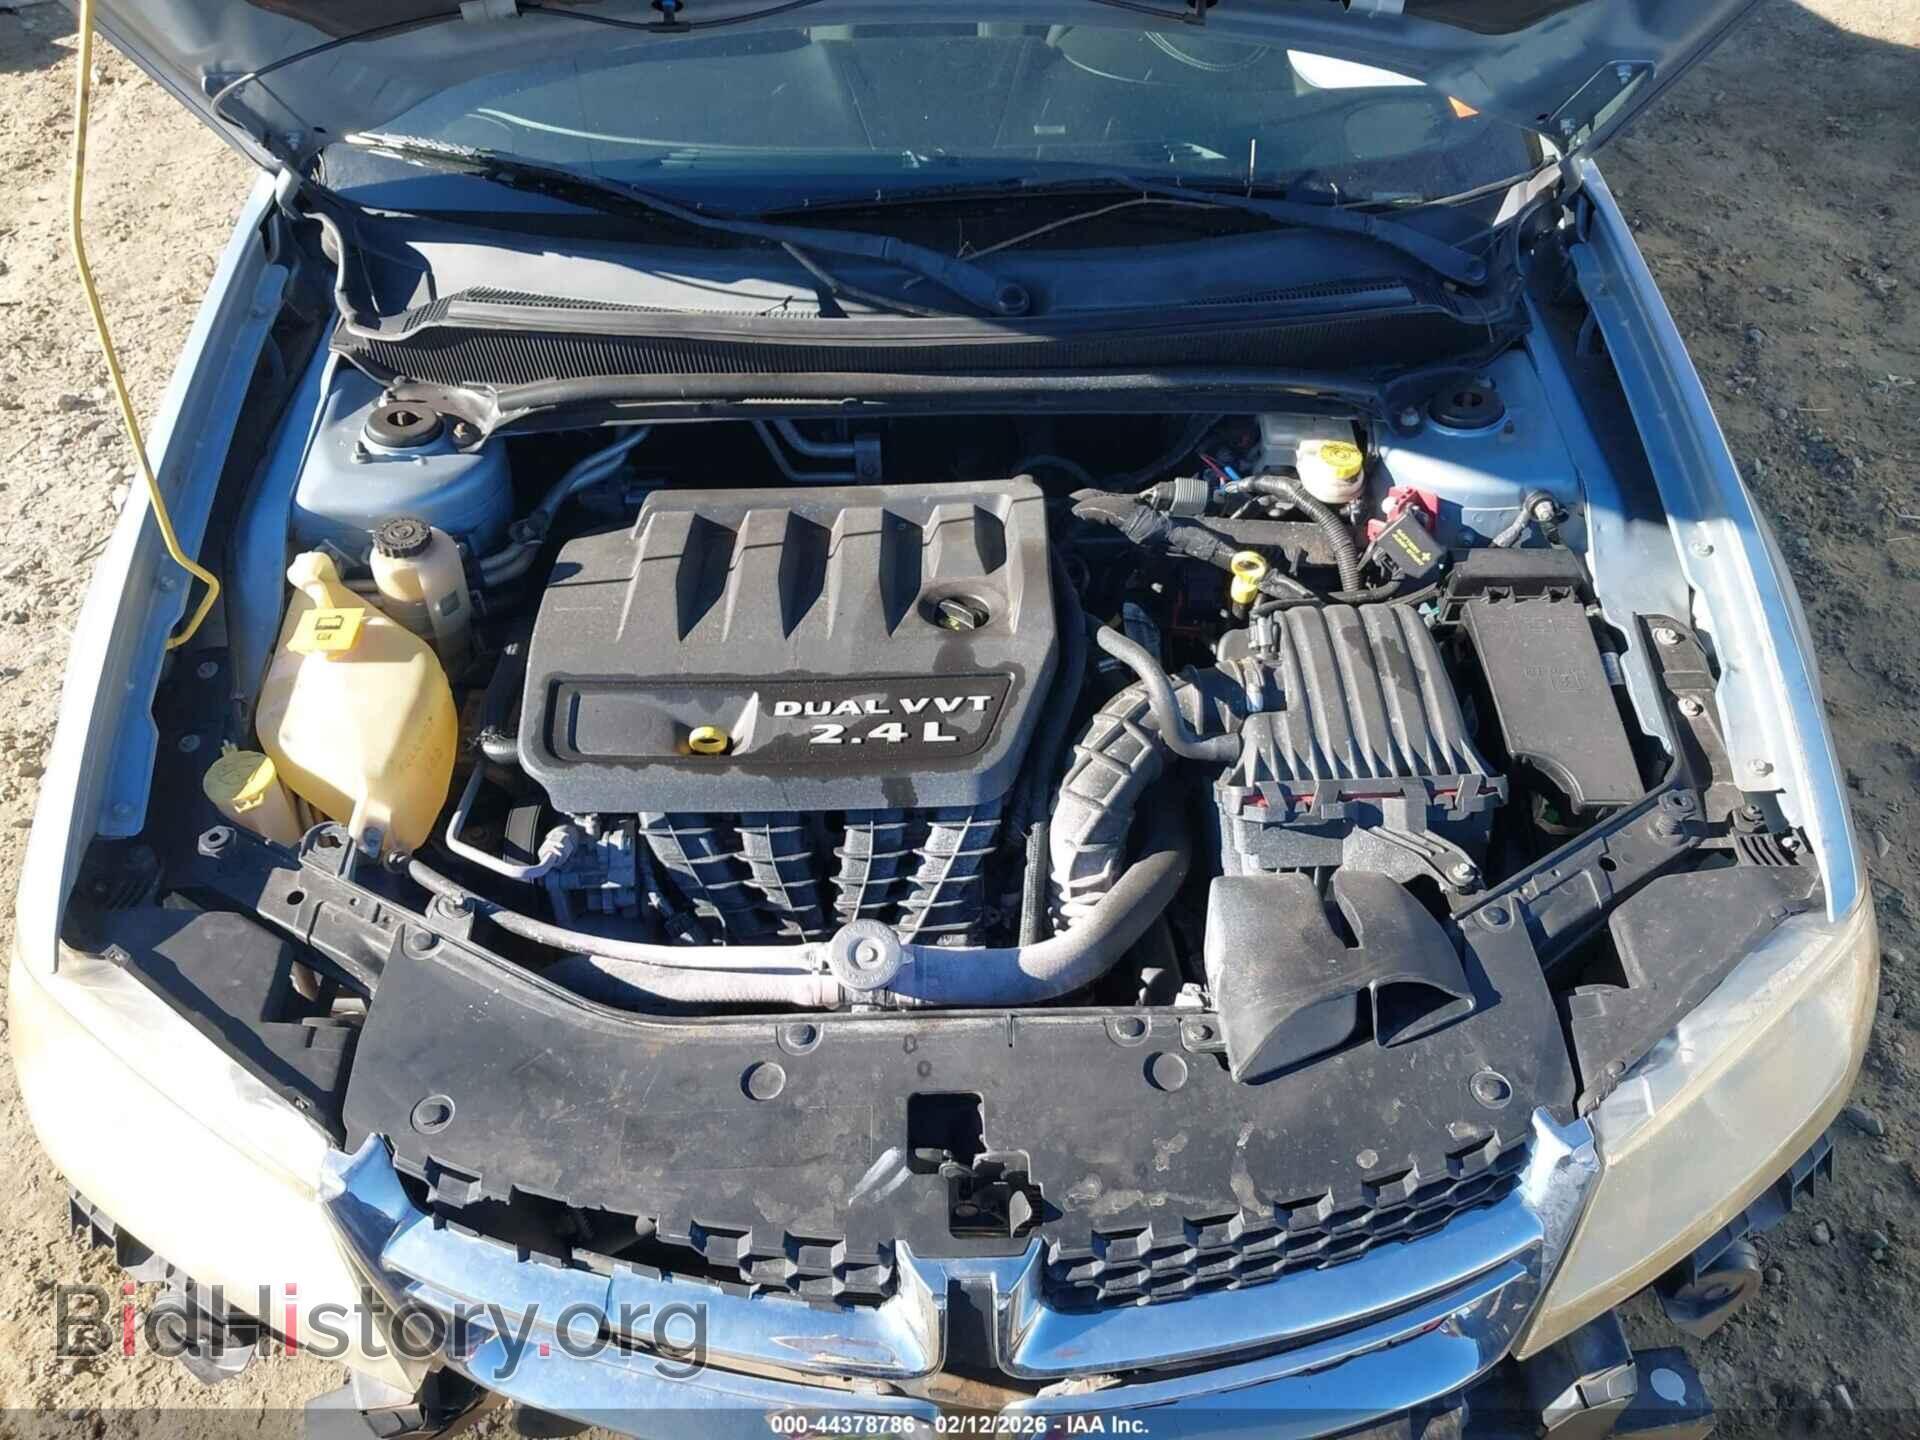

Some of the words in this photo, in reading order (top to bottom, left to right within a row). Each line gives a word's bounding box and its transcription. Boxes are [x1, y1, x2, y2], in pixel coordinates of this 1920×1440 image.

[774, 699, 892, 717] DUAL
[899, 695, 992, 715] VVT
[809, 722, 910, 745] 2.4
[923, 721, 958, 743] L
